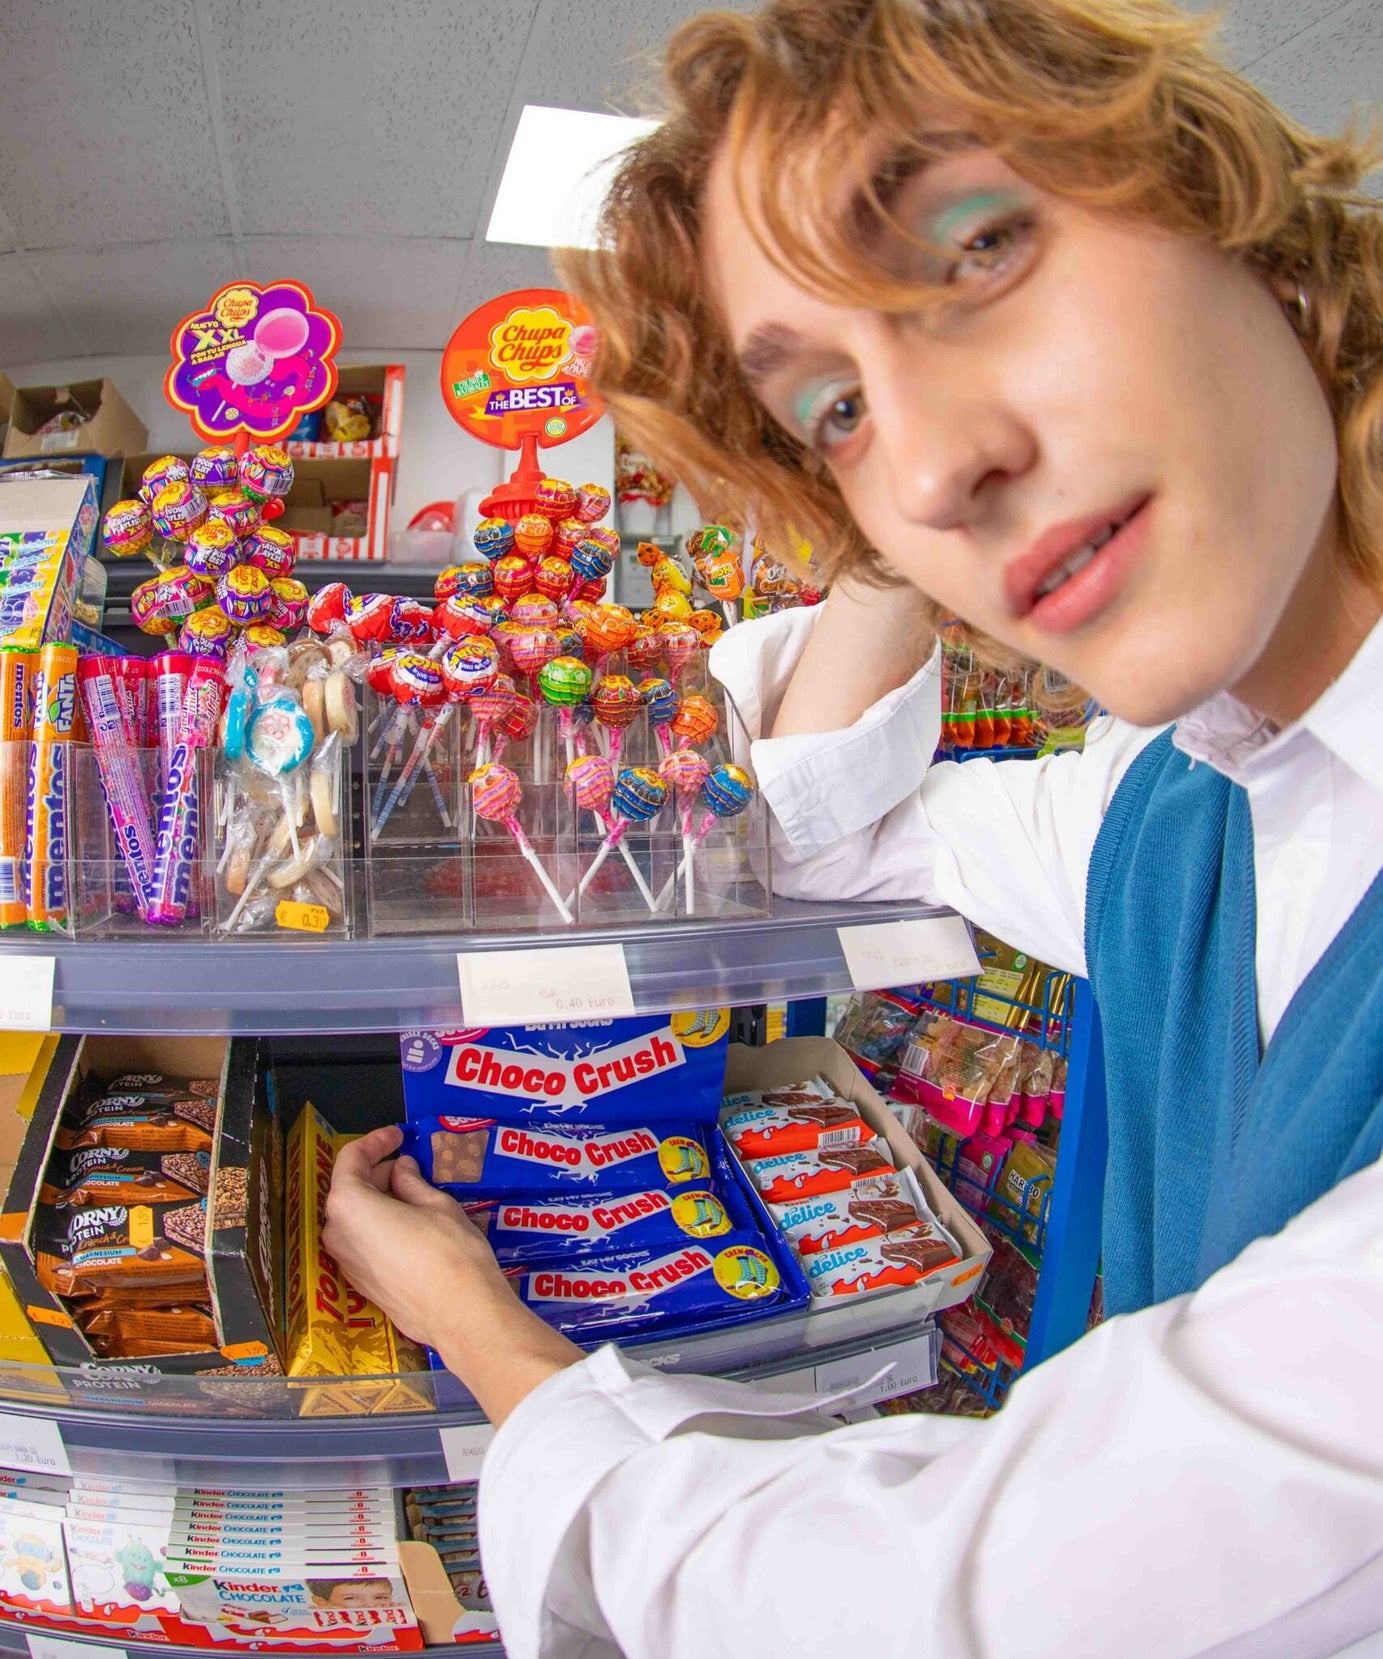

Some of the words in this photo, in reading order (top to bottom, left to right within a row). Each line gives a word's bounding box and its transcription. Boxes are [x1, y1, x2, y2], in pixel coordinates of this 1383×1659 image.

[223, 299, 253, 309] Chupa
[220, 307, 250, 322] Chups
[188, 328, 245, 352] XXL
[502, 324, 566, 345] Chupa
[498, 342, 562, 371] Chups
[489, 401, 509, 411] THE
[509, 386, 565, 410] BEST
[562, 396, 576, 406] OF
[14, 663, 25, 729] mentos
[57, 672, 76, 734] FANTA
[44, 744, 66, 911] mentos
[150, 743, 189, 904] mentos
[587, 994, 617, 1008] Euro
[422, 1032, 440, 1050] SOCKS
[455, 1047, 568, 1097] Choco
[573, 1035, 678, 1095] Crush
[93, 1121, 135, 1129] CHOCOLATE
[501, 1129, 582, 1166] Choco
[585, 1131, 657, 1167] Crush
[70, 1147, 128, 1173] CORNY
[1009, 1169, 1040, 1199] HARBO
[503, 1207, 589, 1232] Choco
[591, 1191, 670, 1231] Crush
[778, 1202, 837, 1232] délice
[75, 1257, 123, 1269] CHOCOLATE
[808, 1247, 869, 1279] délice
[535, 1273, 627, 1299] Choco
[628, 1250, 712, 1296] Crush
[72, 1378, 141, 1390] PROTEIN
[193, 1488, 225, 1497] Kinder
[226, 1490, 270, 1498] CHOCOLATE
[192, 1499, 224, 1508] Kinder
[226, 1501, 269, 1510] CHOCOLATE
[190, 1511, 222, 1519] Kinder
[224, 1513, 268, 1521] CHOCOLATE
[189, 1523, 222, 1531] Kinder
[223, 1525, 267, 1533] CHOCOLATE
[187, 1535, 220, 1543] Kinder
[222, 1537, 266, 1546] CHOCOLATE
[185, 1548, 219, 1557] Kinder
[220, 1550, 266, 1559] CHOCOLATE
[182, 1562, 217, 1572] Kinder
[219, 1565, 265, 1574] CHOCOLATE
[212, 1579, 279, 1593] Kinder
[219, 1591, 306, 1604] CHOCOLATE
